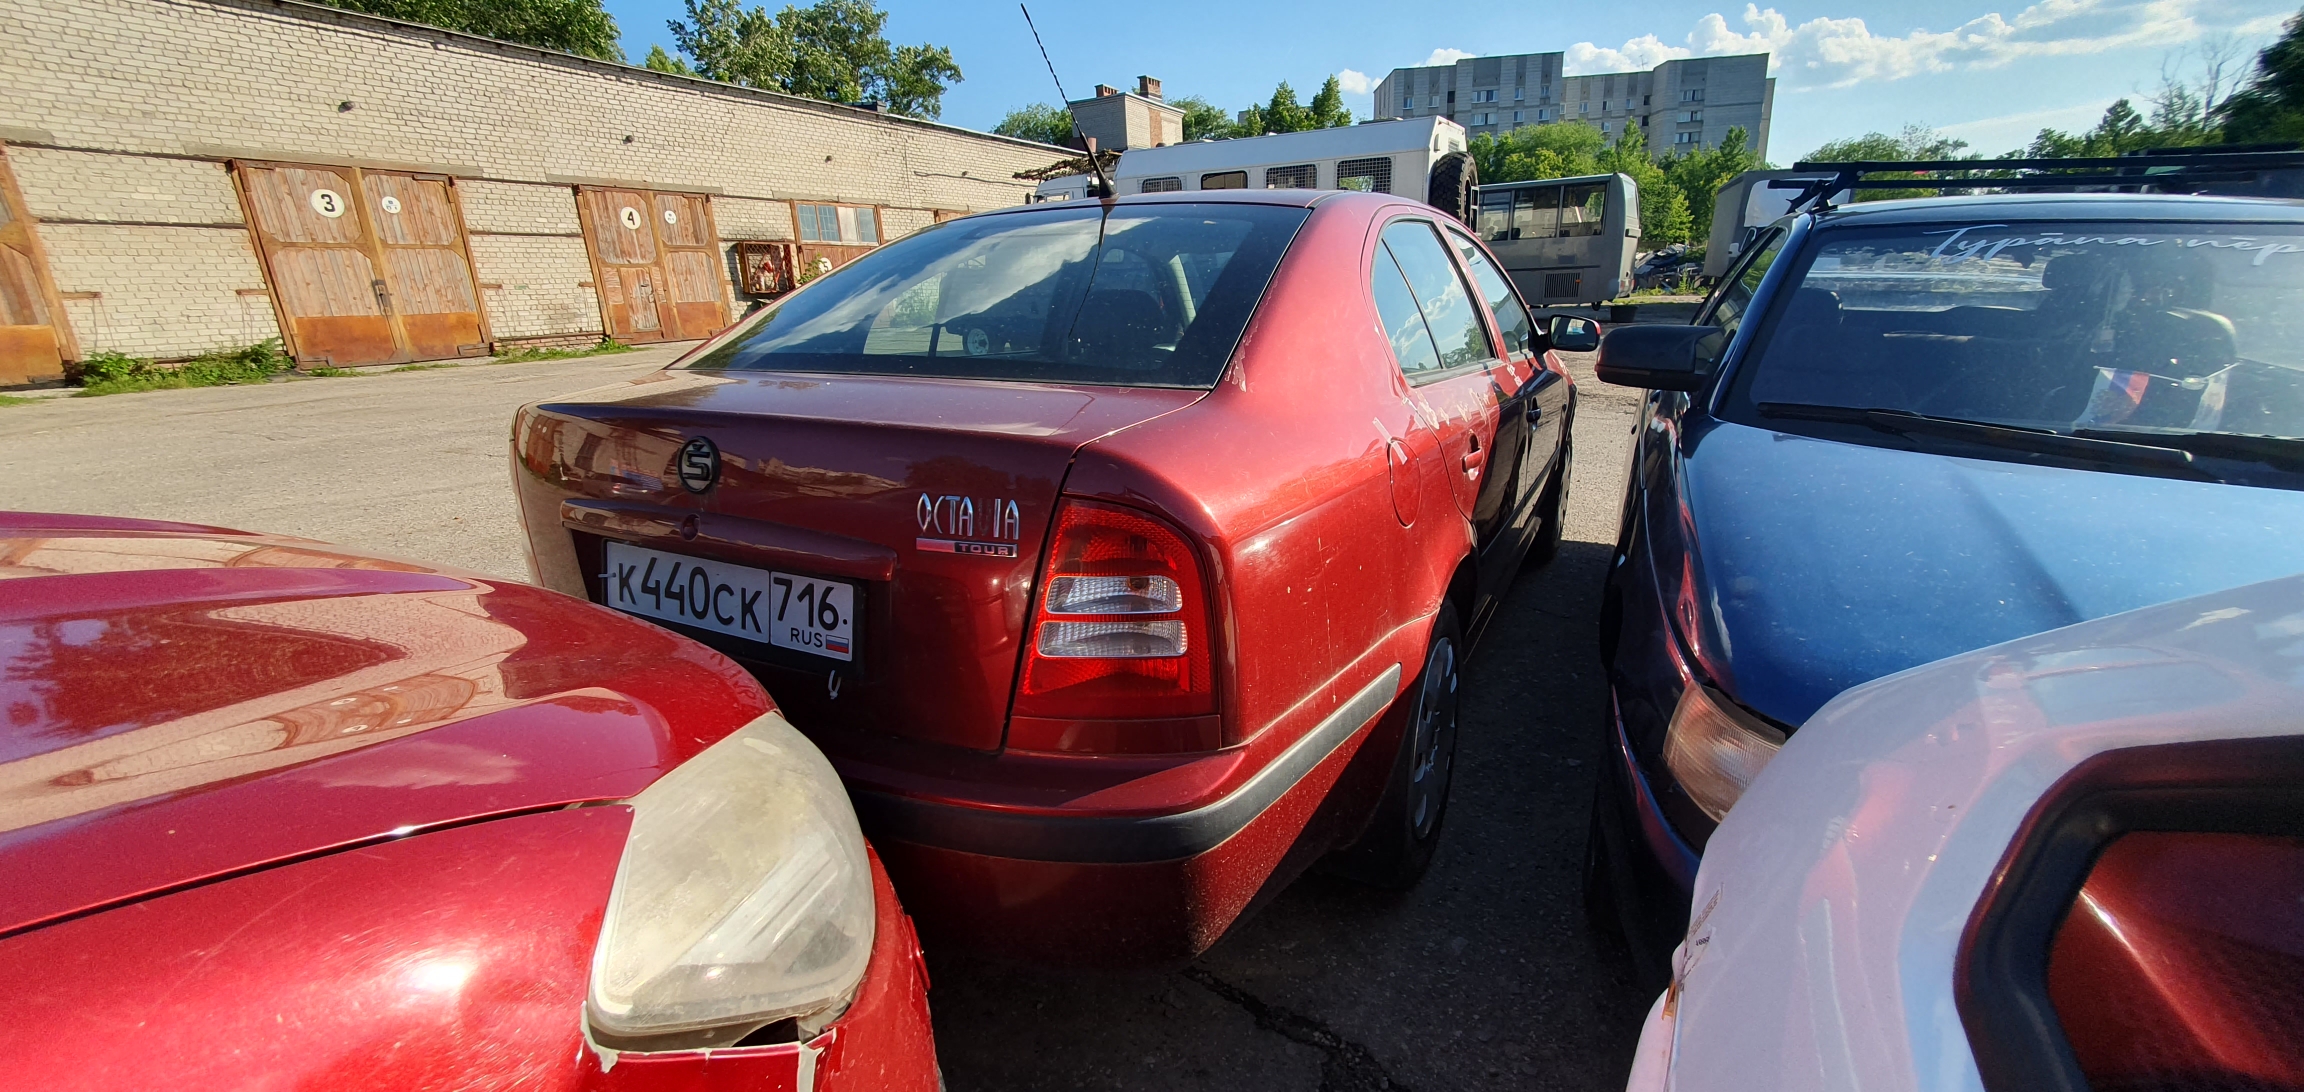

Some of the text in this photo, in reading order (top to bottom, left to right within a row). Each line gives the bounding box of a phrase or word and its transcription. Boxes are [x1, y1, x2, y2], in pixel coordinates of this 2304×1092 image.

[321, 194, 336, 212] 3
[627, 211, 636, 225] 4
[959, 543, 1009, 556] TOUR
[773, 576, 839, 631] 716
[790, 627, 823, 648] RUS
